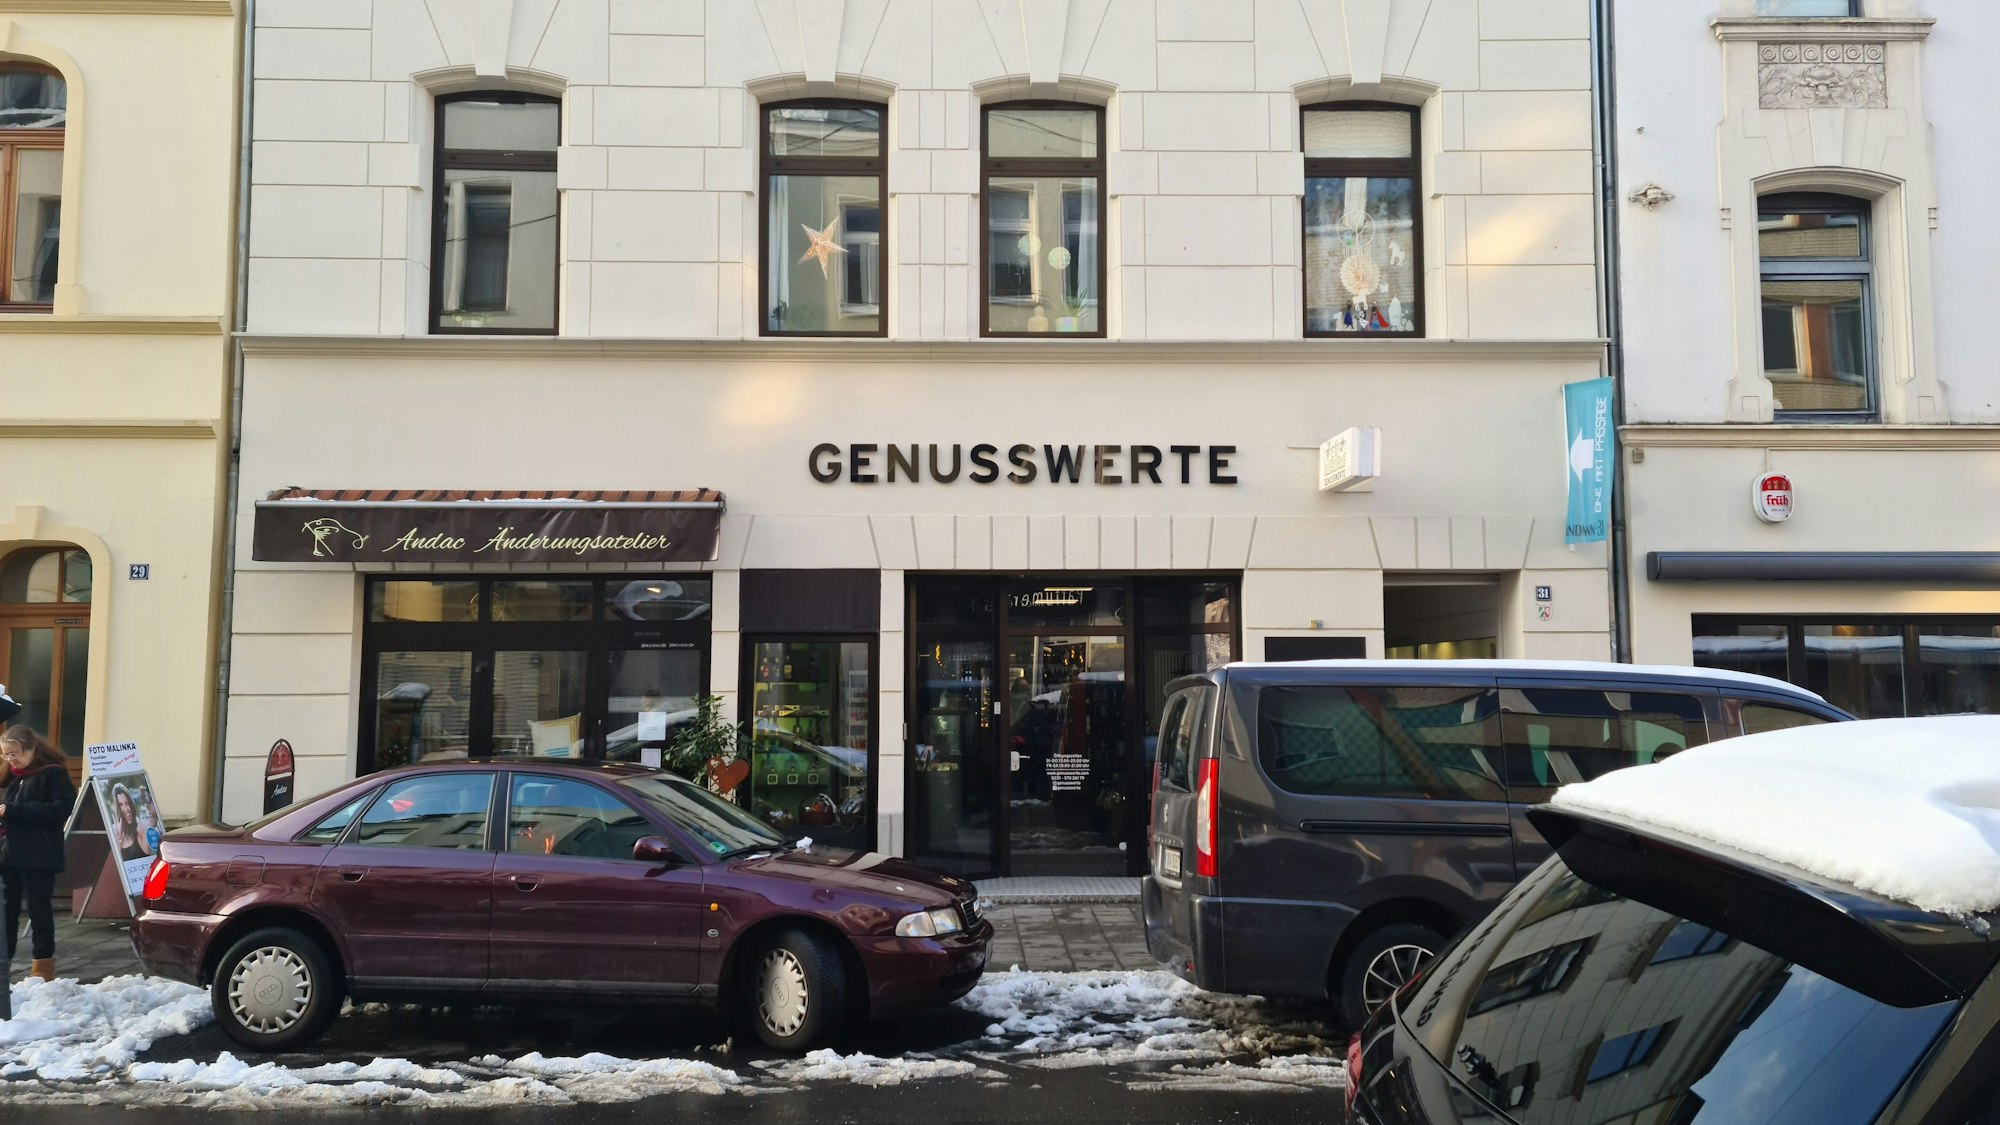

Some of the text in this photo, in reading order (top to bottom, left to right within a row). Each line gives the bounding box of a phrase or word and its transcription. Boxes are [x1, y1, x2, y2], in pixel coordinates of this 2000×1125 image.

[1595, 396, 1607, 452] PASSAGE
[808, 443, 1238, 484] GENUSSWERTE
[1595, 458, 1604, 482] ART
[382, 527, 671, 555] Andac Änderungsatelier
[132, 565, 146, 578] 29
[1537, 587, 1550, 599] 31
[89, 742, 137, 755] FOTO MALINKA
